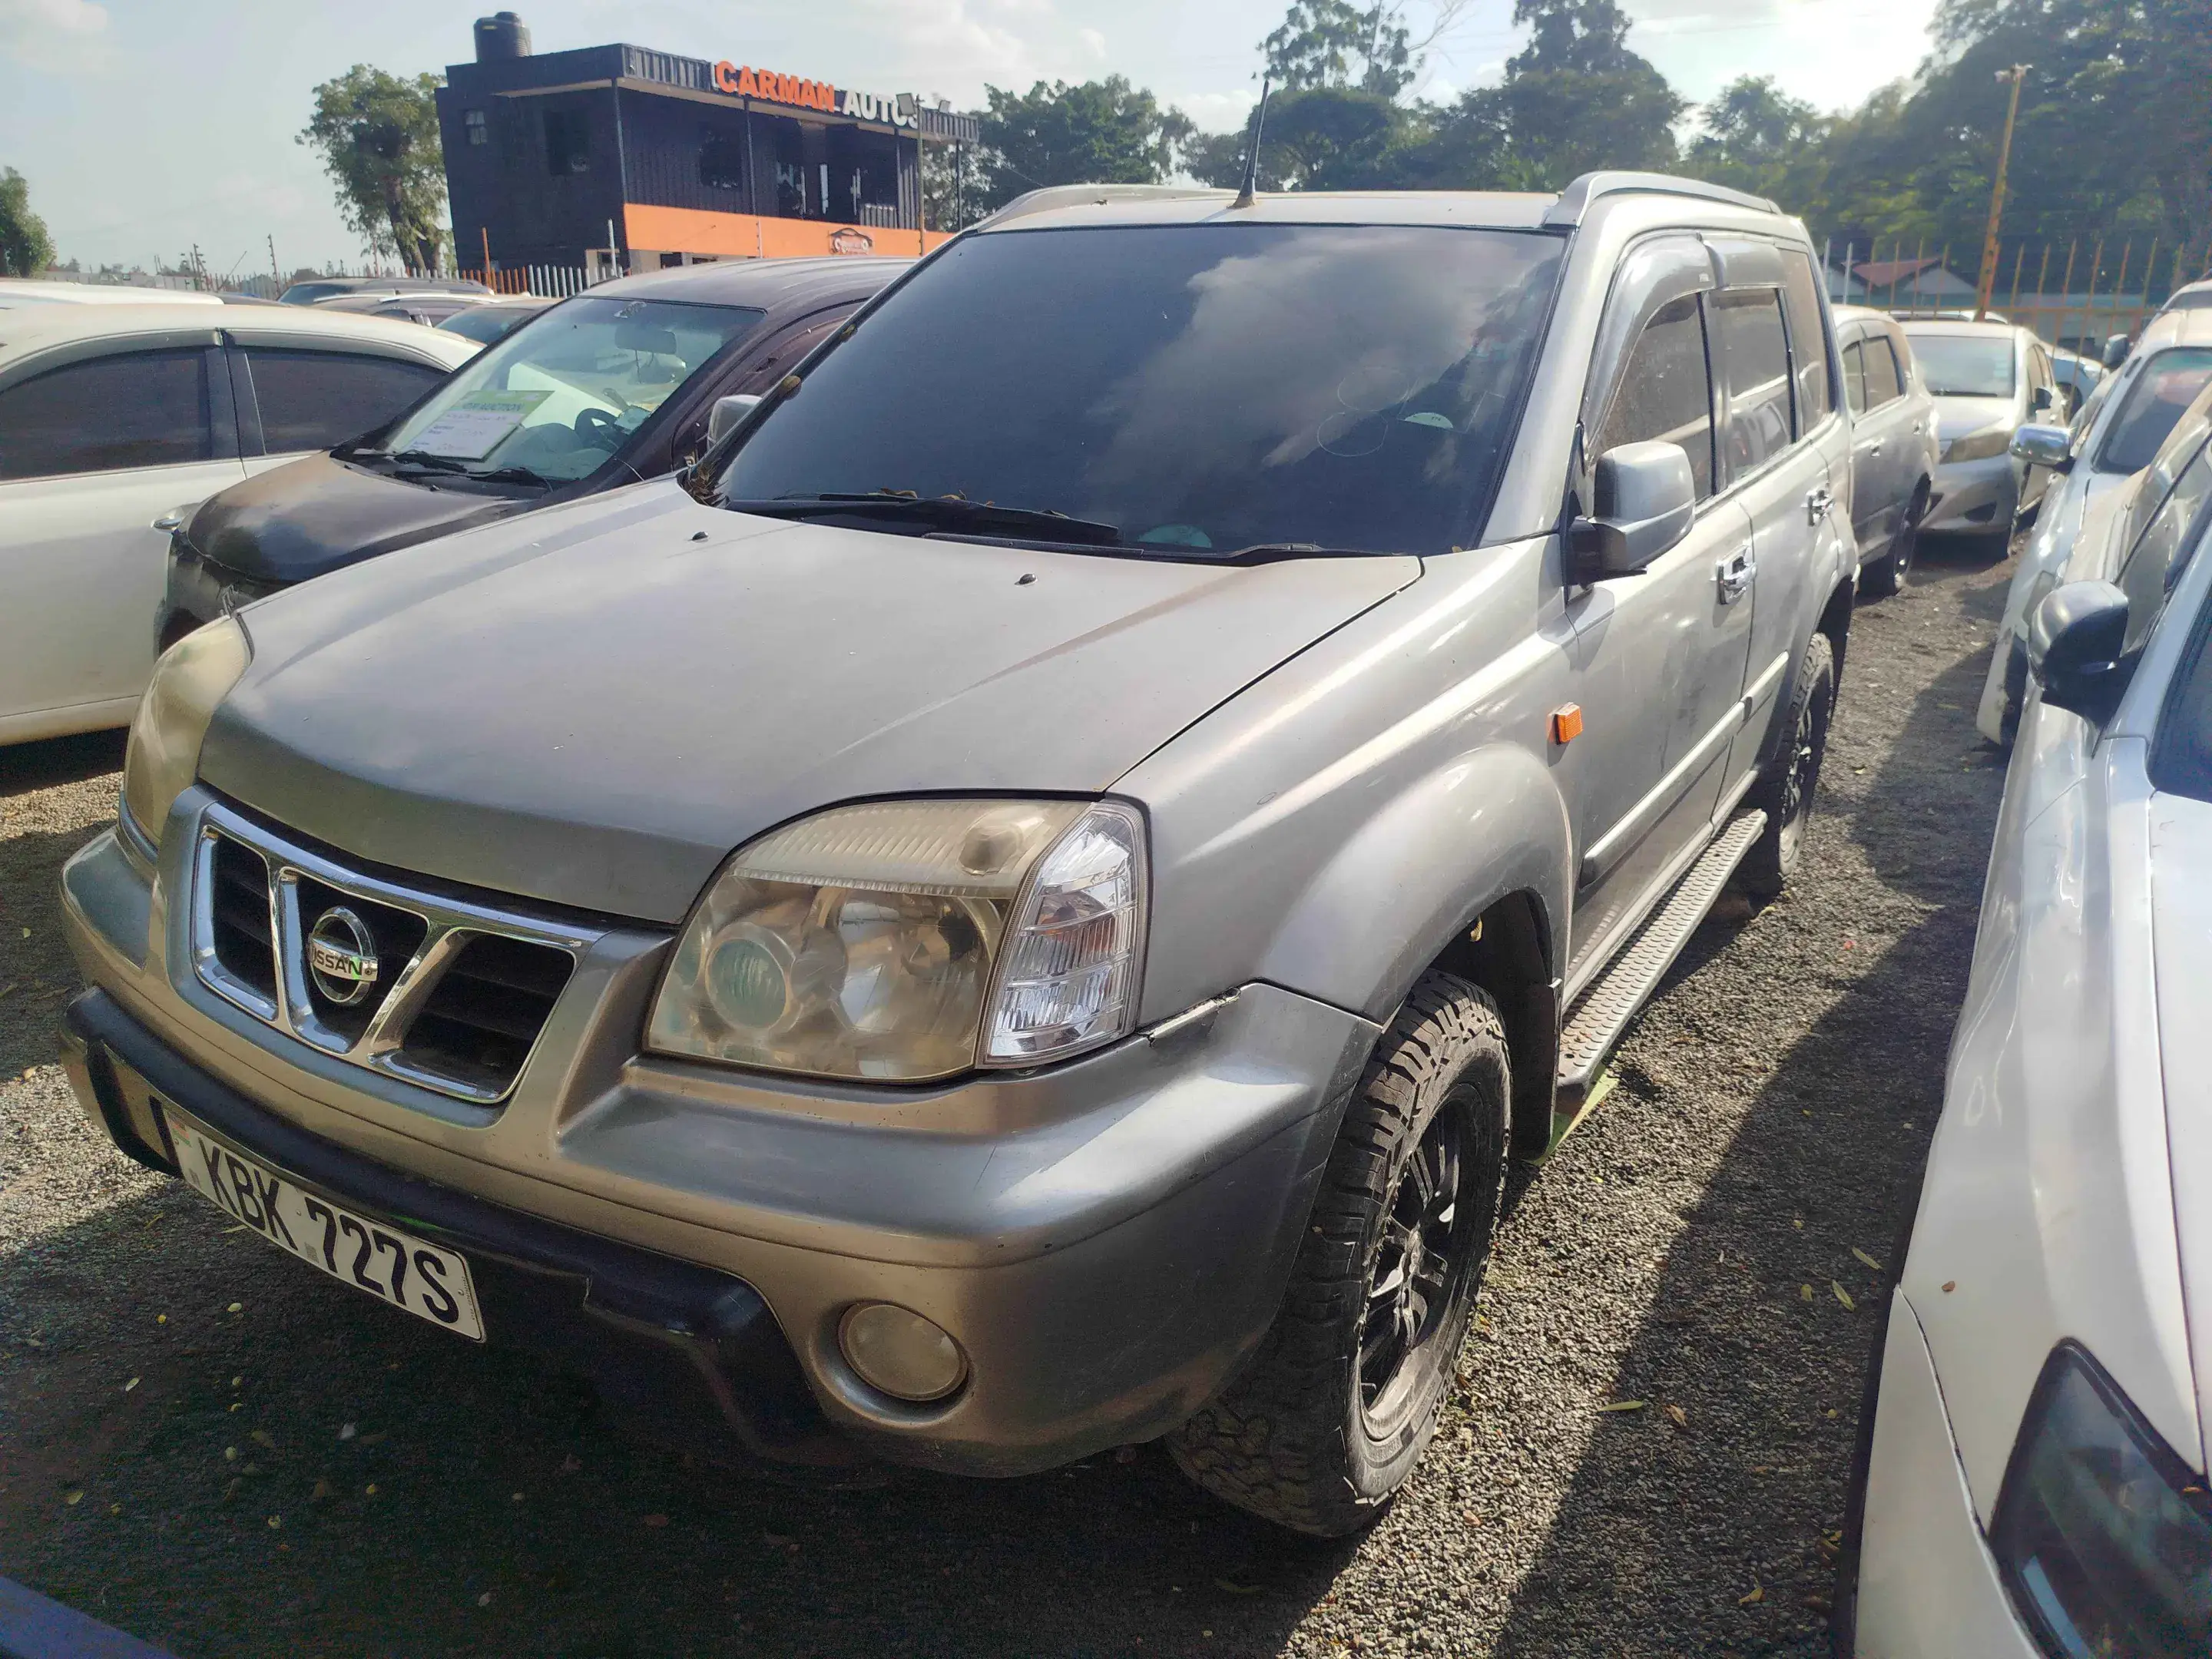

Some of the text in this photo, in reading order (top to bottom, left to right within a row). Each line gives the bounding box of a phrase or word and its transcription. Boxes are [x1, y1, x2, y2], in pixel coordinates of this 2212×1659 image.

[715, 60, 835, 113] CARMAN
[313, 945, 363, 975] ISSAN
[198, 1137, 459, 1324] KBK 727S
